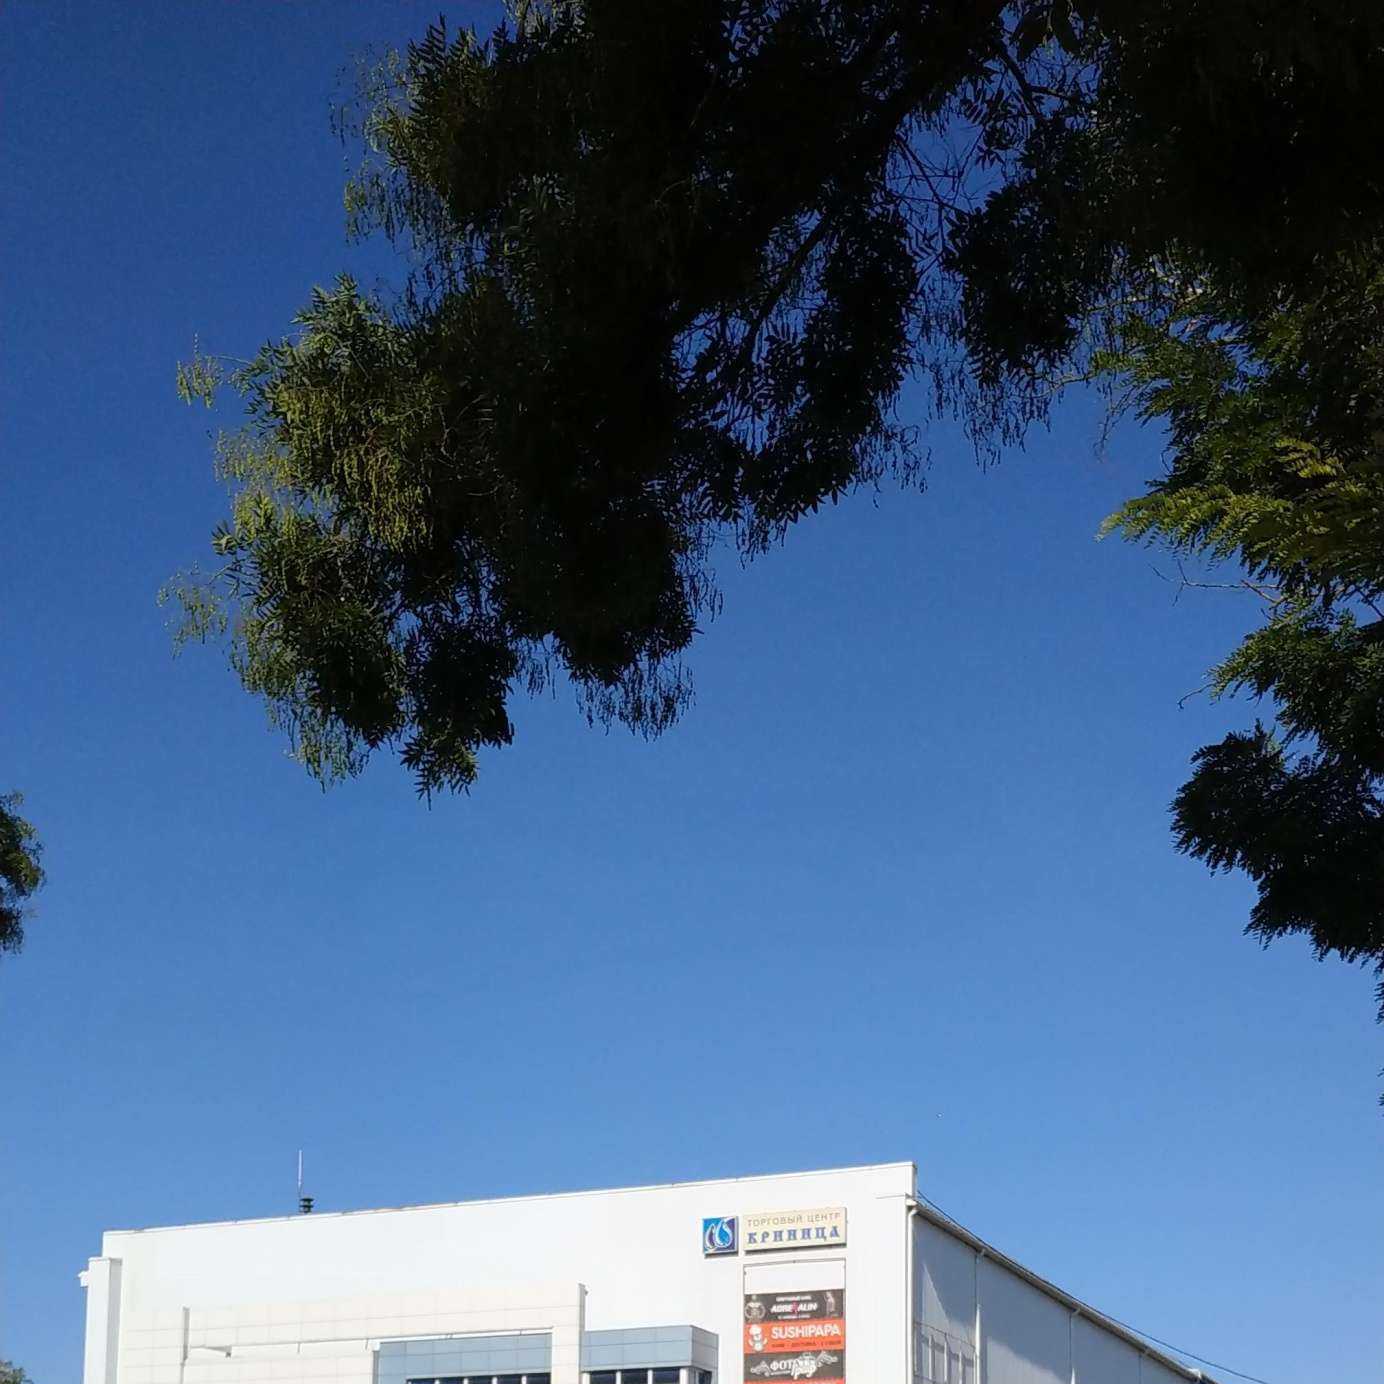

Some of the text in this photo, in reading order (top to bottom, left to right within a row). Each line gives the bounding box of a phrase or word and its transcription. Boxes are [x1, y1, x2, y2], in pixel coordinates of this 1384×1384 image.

[747, 1212, 841, 1227] ТОРГОВЫЙ ЦЕНТР
[748, 1226, 840, 1244] КРИНИЦА
[771, 1324, 840, 1339] SUSHIPAPA
